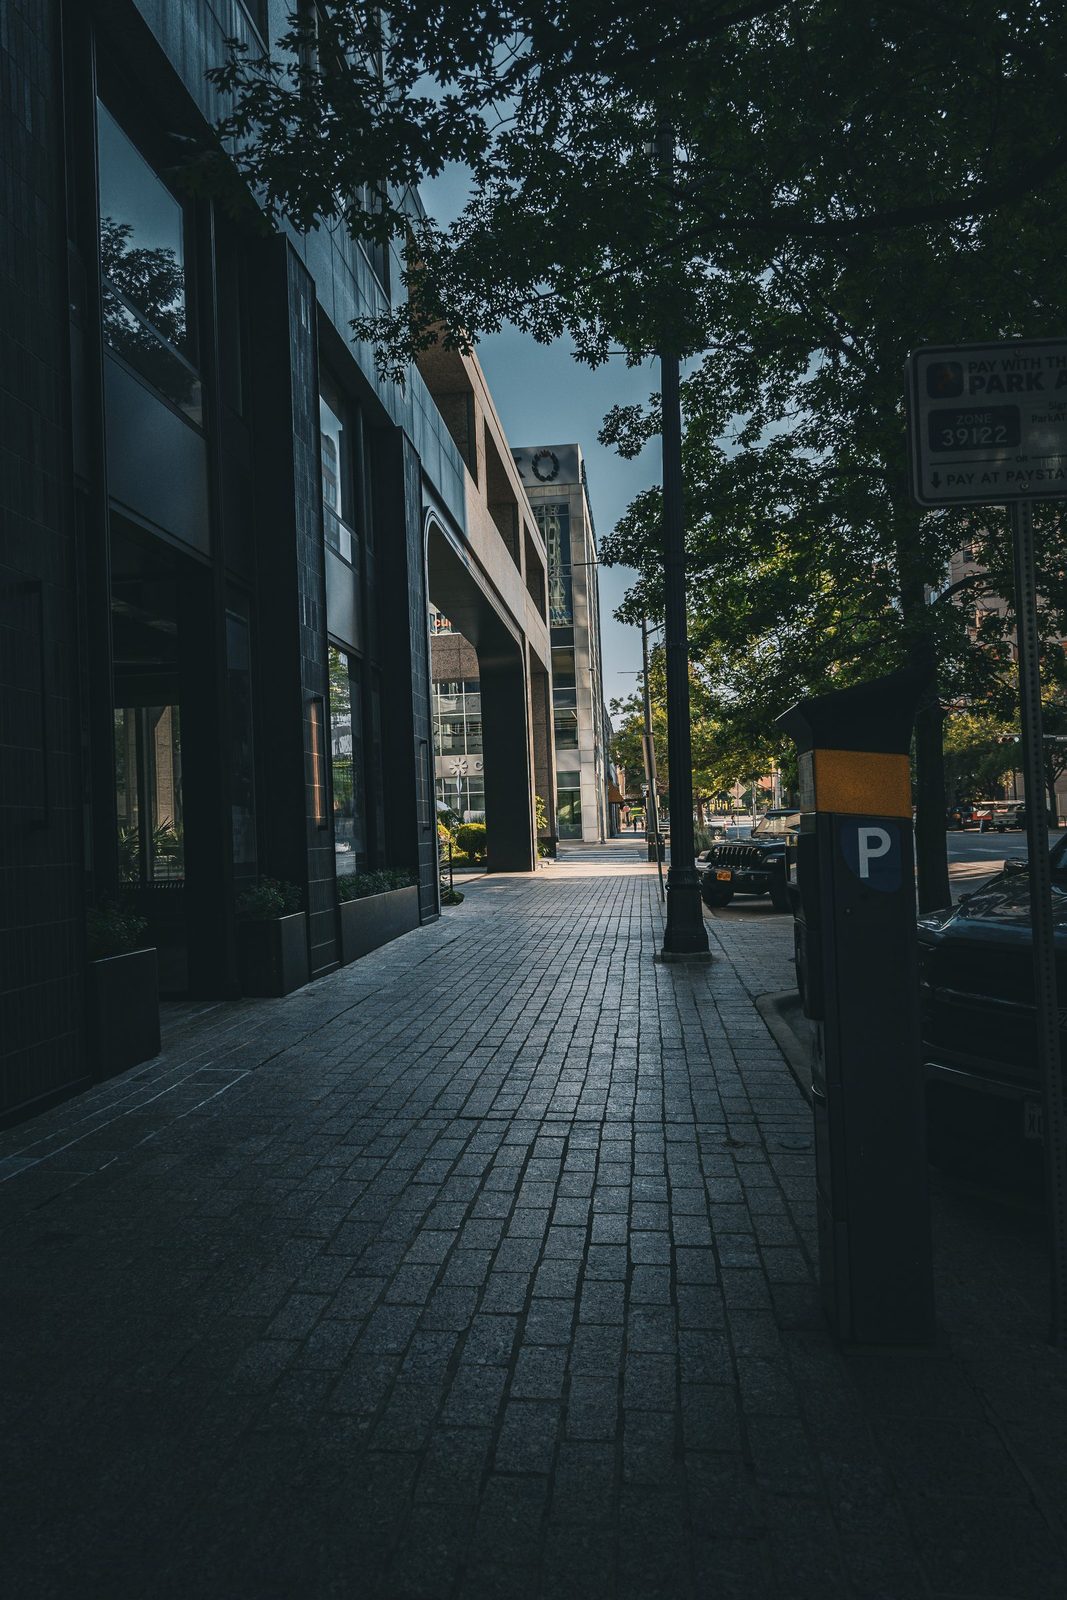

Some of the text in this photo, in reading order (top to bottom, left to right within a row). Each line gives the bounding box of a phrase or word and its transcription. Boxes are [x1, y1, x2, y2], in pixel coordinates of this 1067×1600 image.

[968, 360, 998, 374] PAY
[1001, 357, 1041, 371] WITH
[968, 371, 1045, 395] PARK
[956, 413, 994, 426] ZONE
[941, 425, 1008, 447] 39122
[1016, 455, 1028, 463] OR
[947, 468, 1067, 486] PAY AT PAYSTA
[857, 827, 892, 879] P
